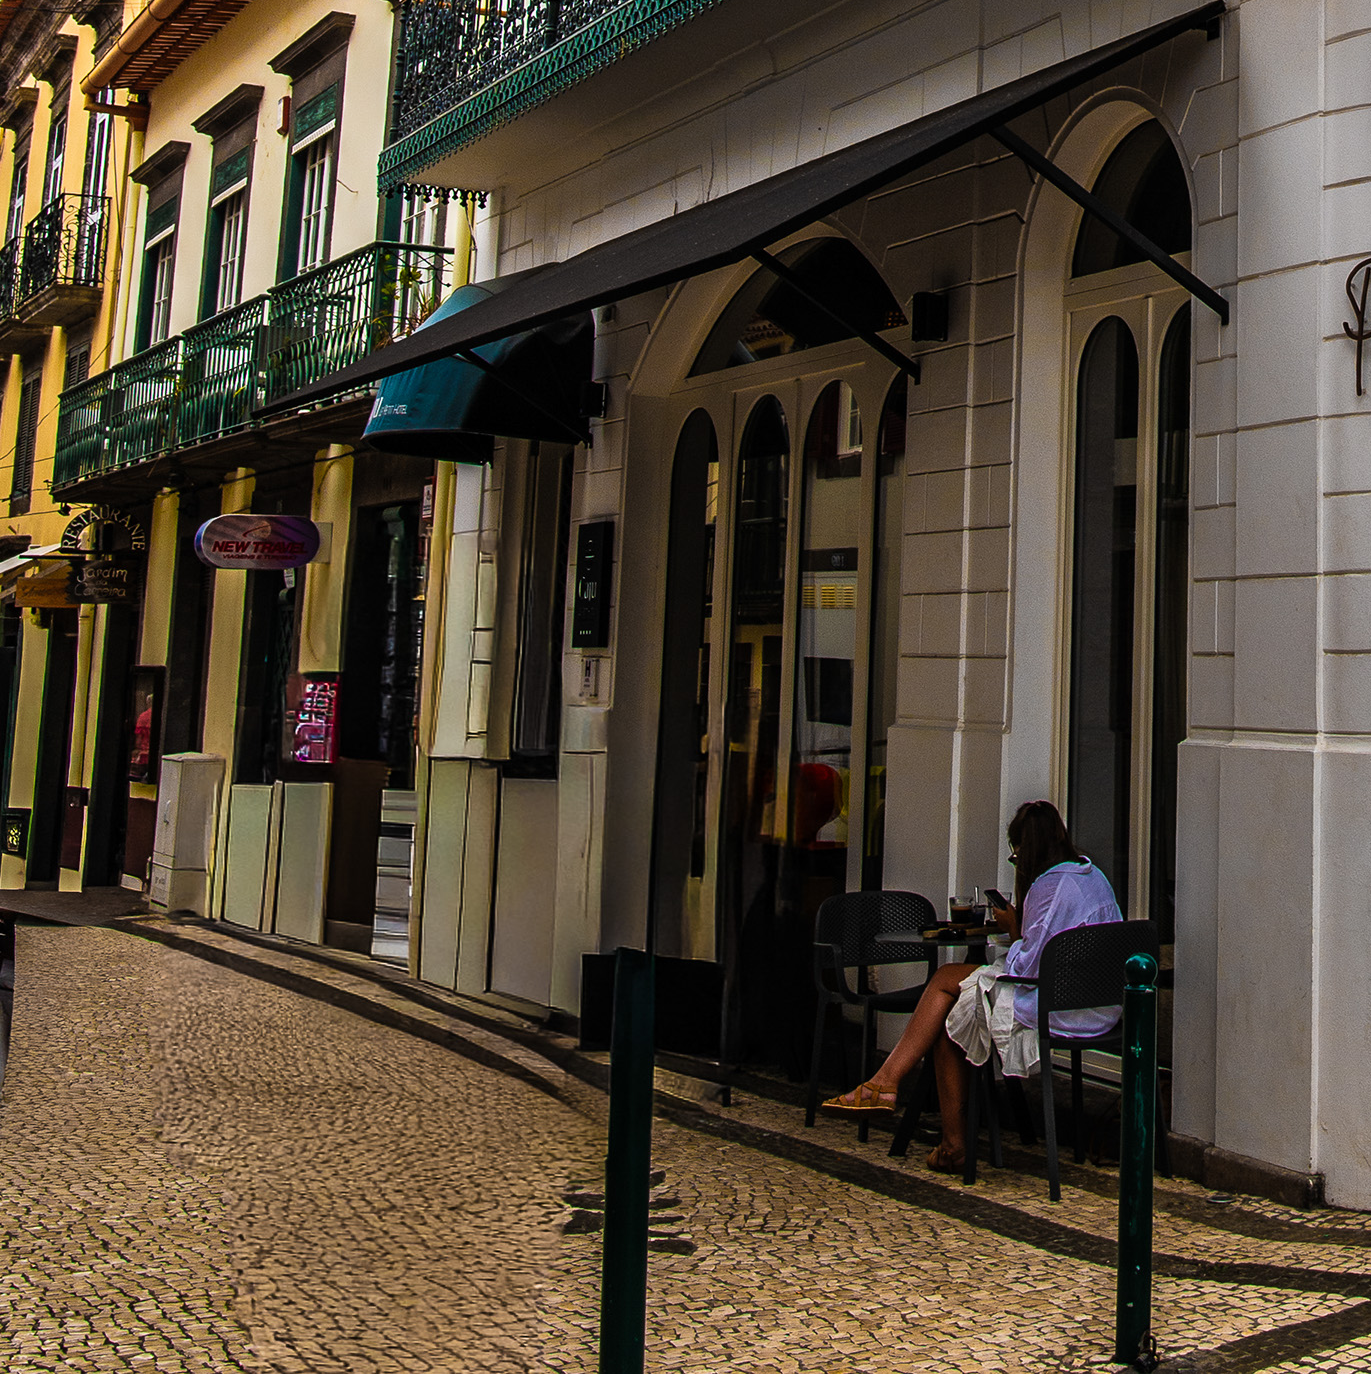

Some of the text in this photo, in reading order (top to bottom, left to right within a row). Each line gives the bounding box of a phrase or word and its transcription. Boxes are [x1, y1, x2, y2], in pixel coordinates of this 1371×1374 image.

[61, 504, 146, 551] RESTAURANTE
[211, 540, 309, 555] NEW TRAVEL
[76, 567, 128, 583] Jardim
